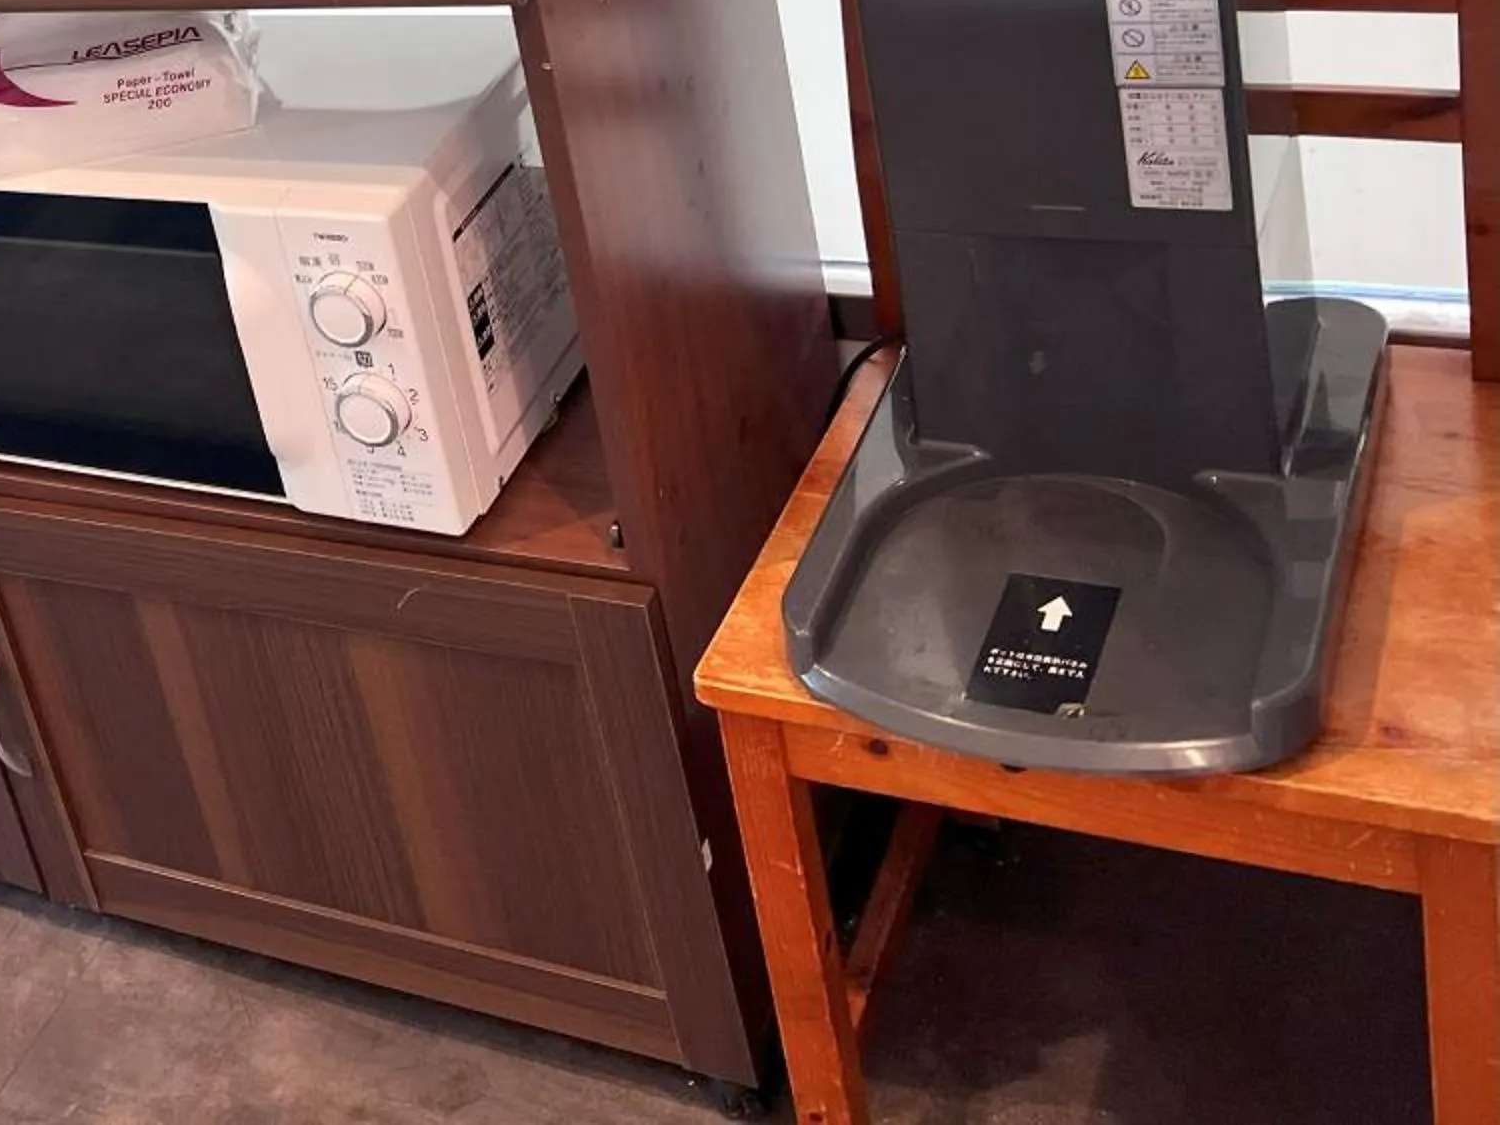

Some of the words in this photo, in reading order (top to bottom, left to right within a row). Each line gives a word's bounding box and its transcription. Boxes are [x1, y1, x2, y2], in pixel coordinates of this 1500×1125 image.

[72, 26, 200, 62] LEASEPIA
[117, 76, 152, 89] Paper
[162, 68, 196, 82] Towel
[103, 89, 152, 104] SPECIAL
[155, 78, 211, 96] ECONOMY
[408, 387, 420, 402] 2
[418, 428, 429, 442] 3
